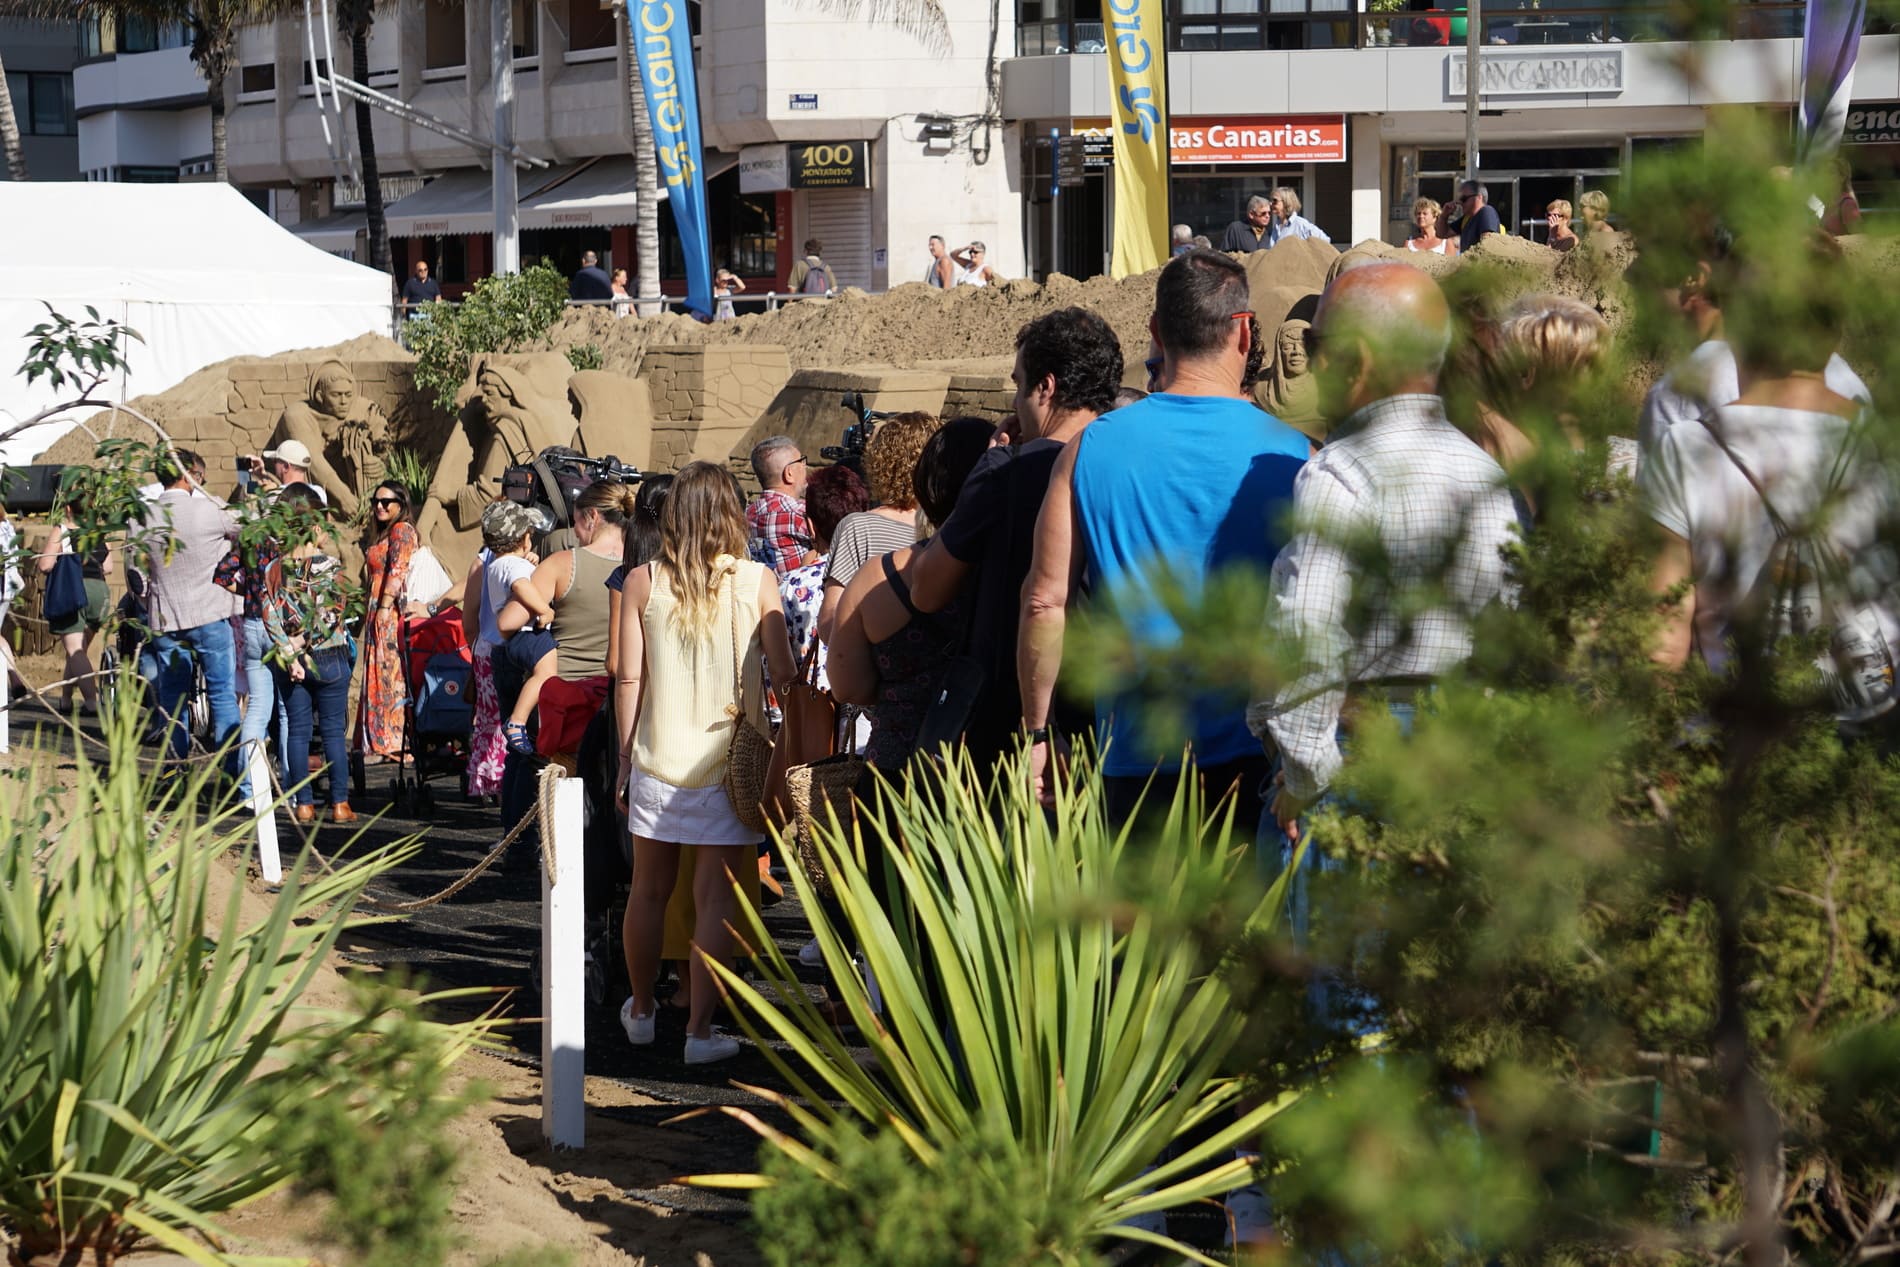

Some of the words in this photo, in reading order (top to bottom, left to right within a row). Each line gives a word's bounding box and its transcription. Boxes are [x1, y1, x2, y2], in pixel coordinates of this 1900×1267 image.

[641, 0, 686, 133] GranC
[1512, 58, 1617, 87] CARLOS
[801, 144, 854, 167] 100
[800, 167, 854, 178] MONTADITOS
